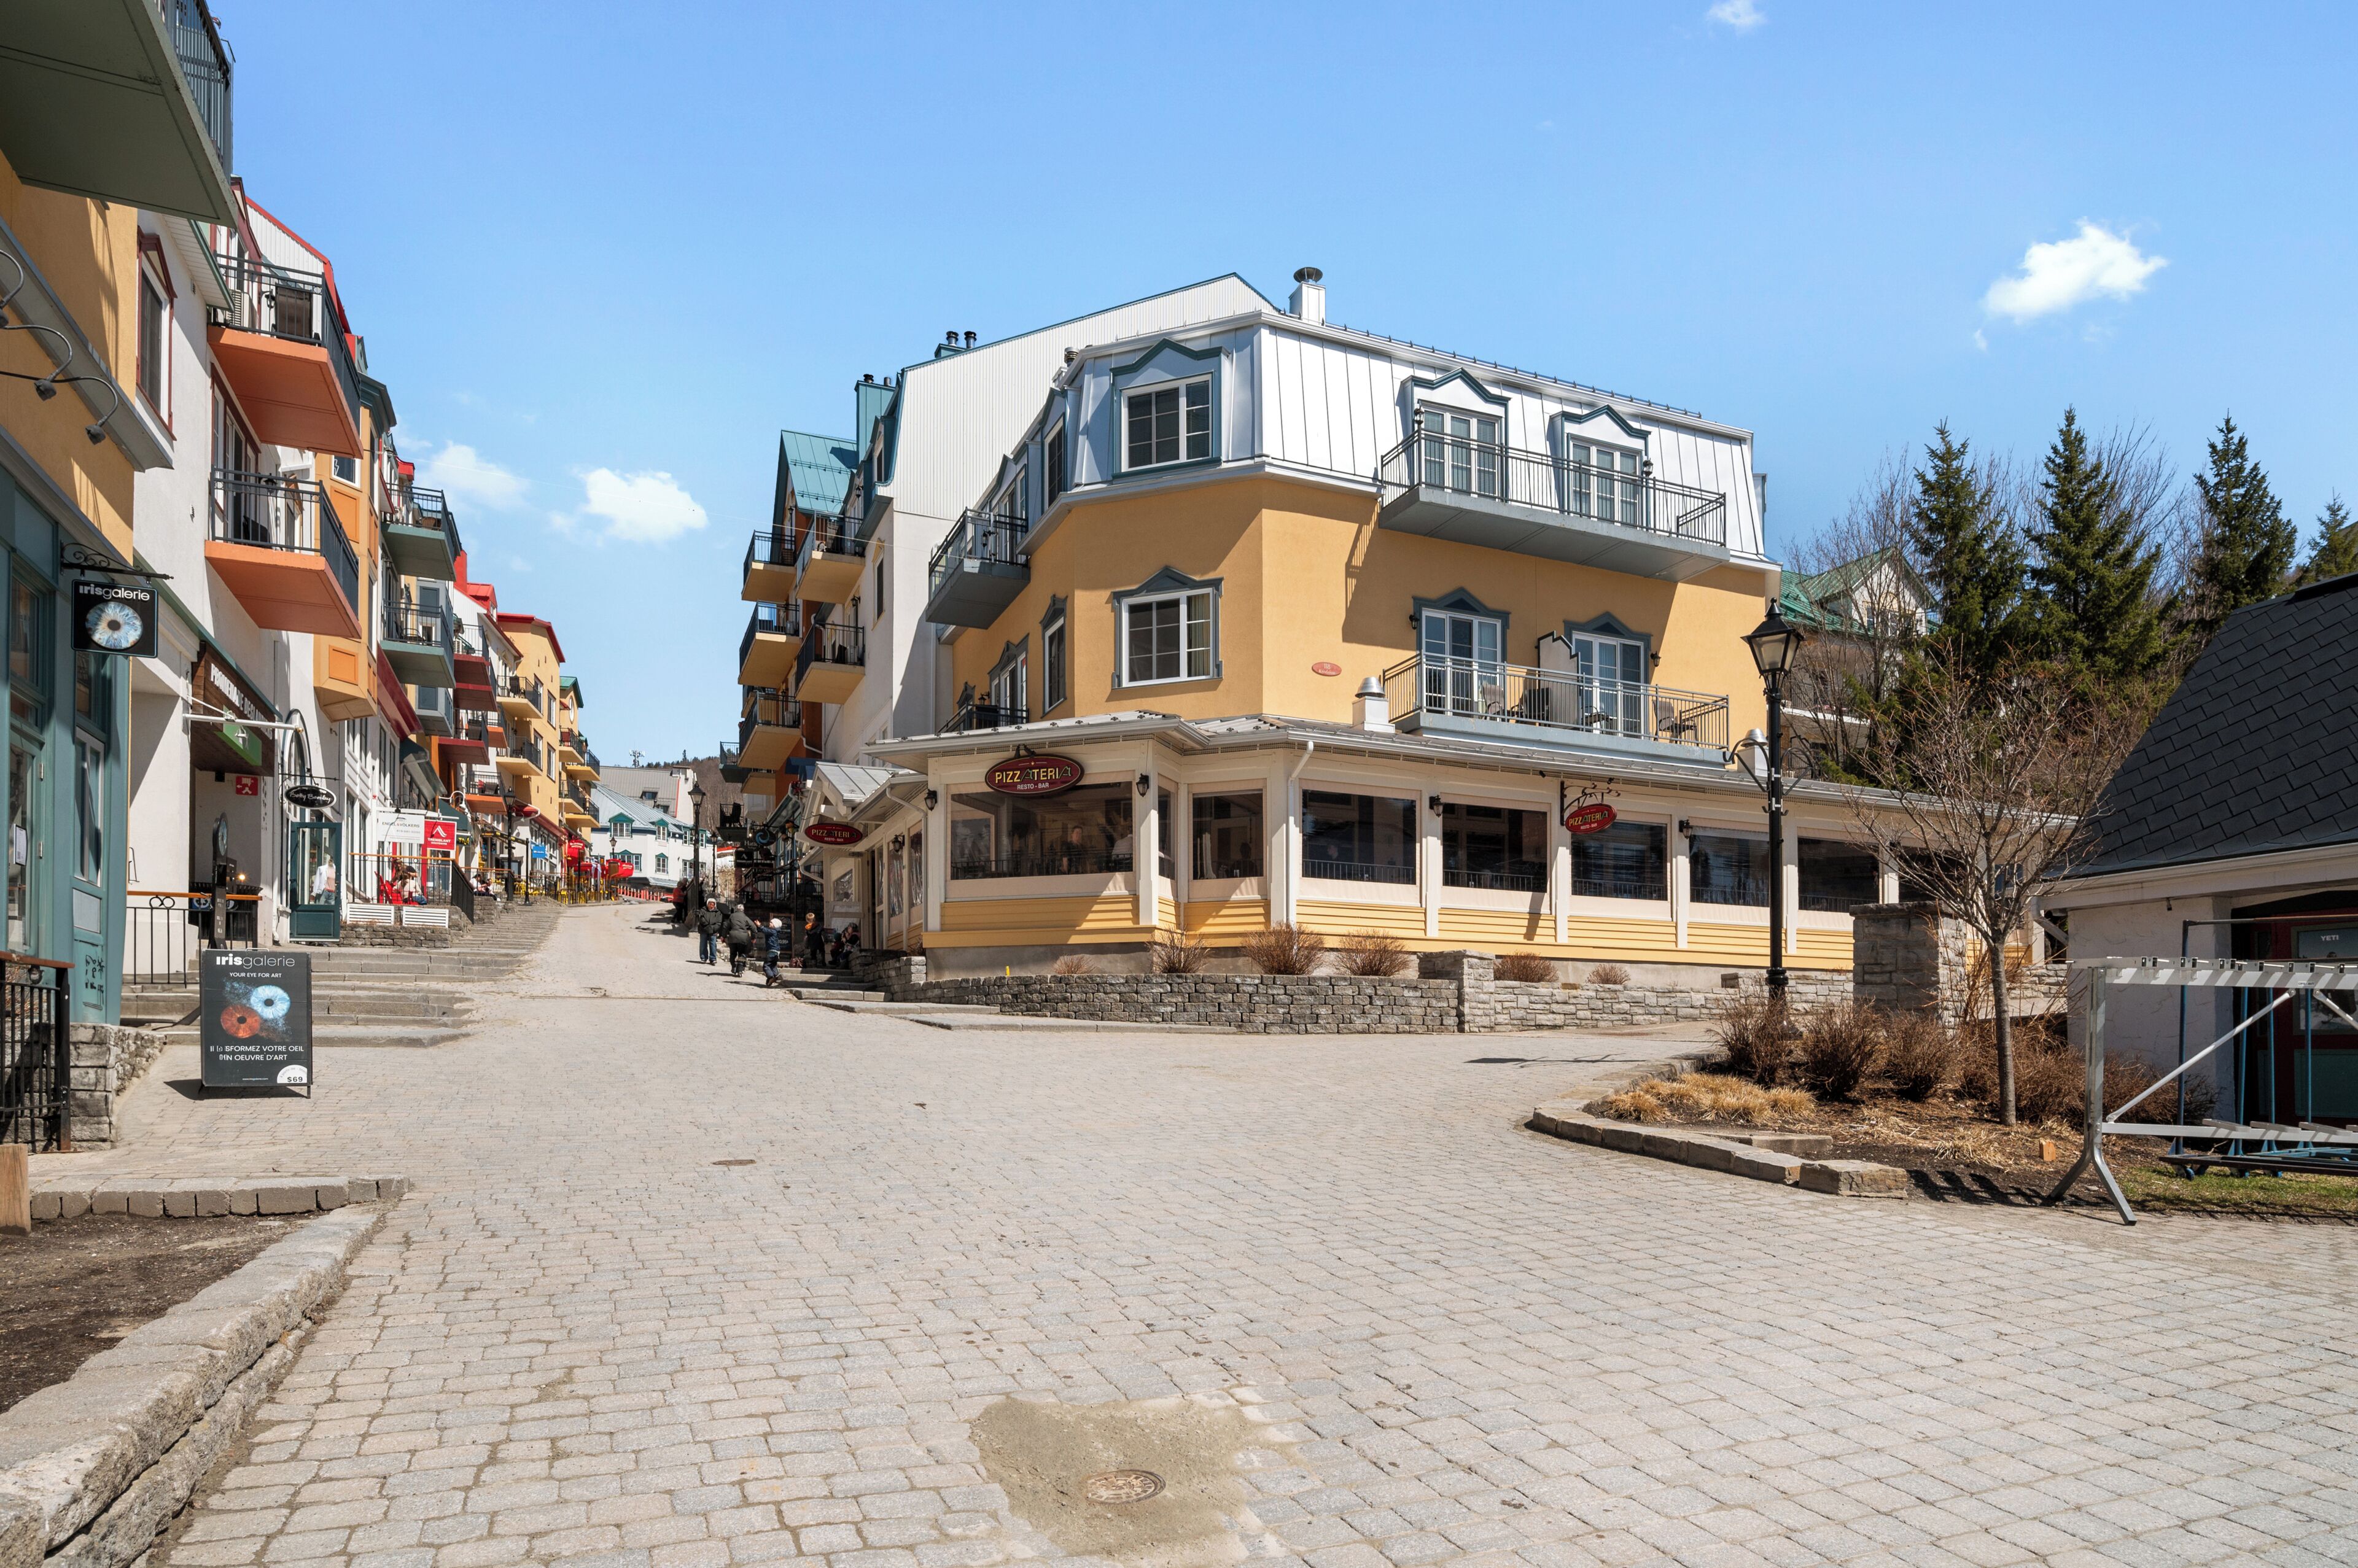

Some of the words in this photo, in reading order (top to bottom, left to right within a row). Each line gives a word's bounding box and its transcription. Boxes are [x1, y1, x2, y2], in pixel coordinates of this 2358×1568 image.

[995, 766, 1072, 783] PIZZATERIA
[1569, 810, 1608, 826] PIZZATERIA
[812, 829, 856, 838] PIZZATERIA
